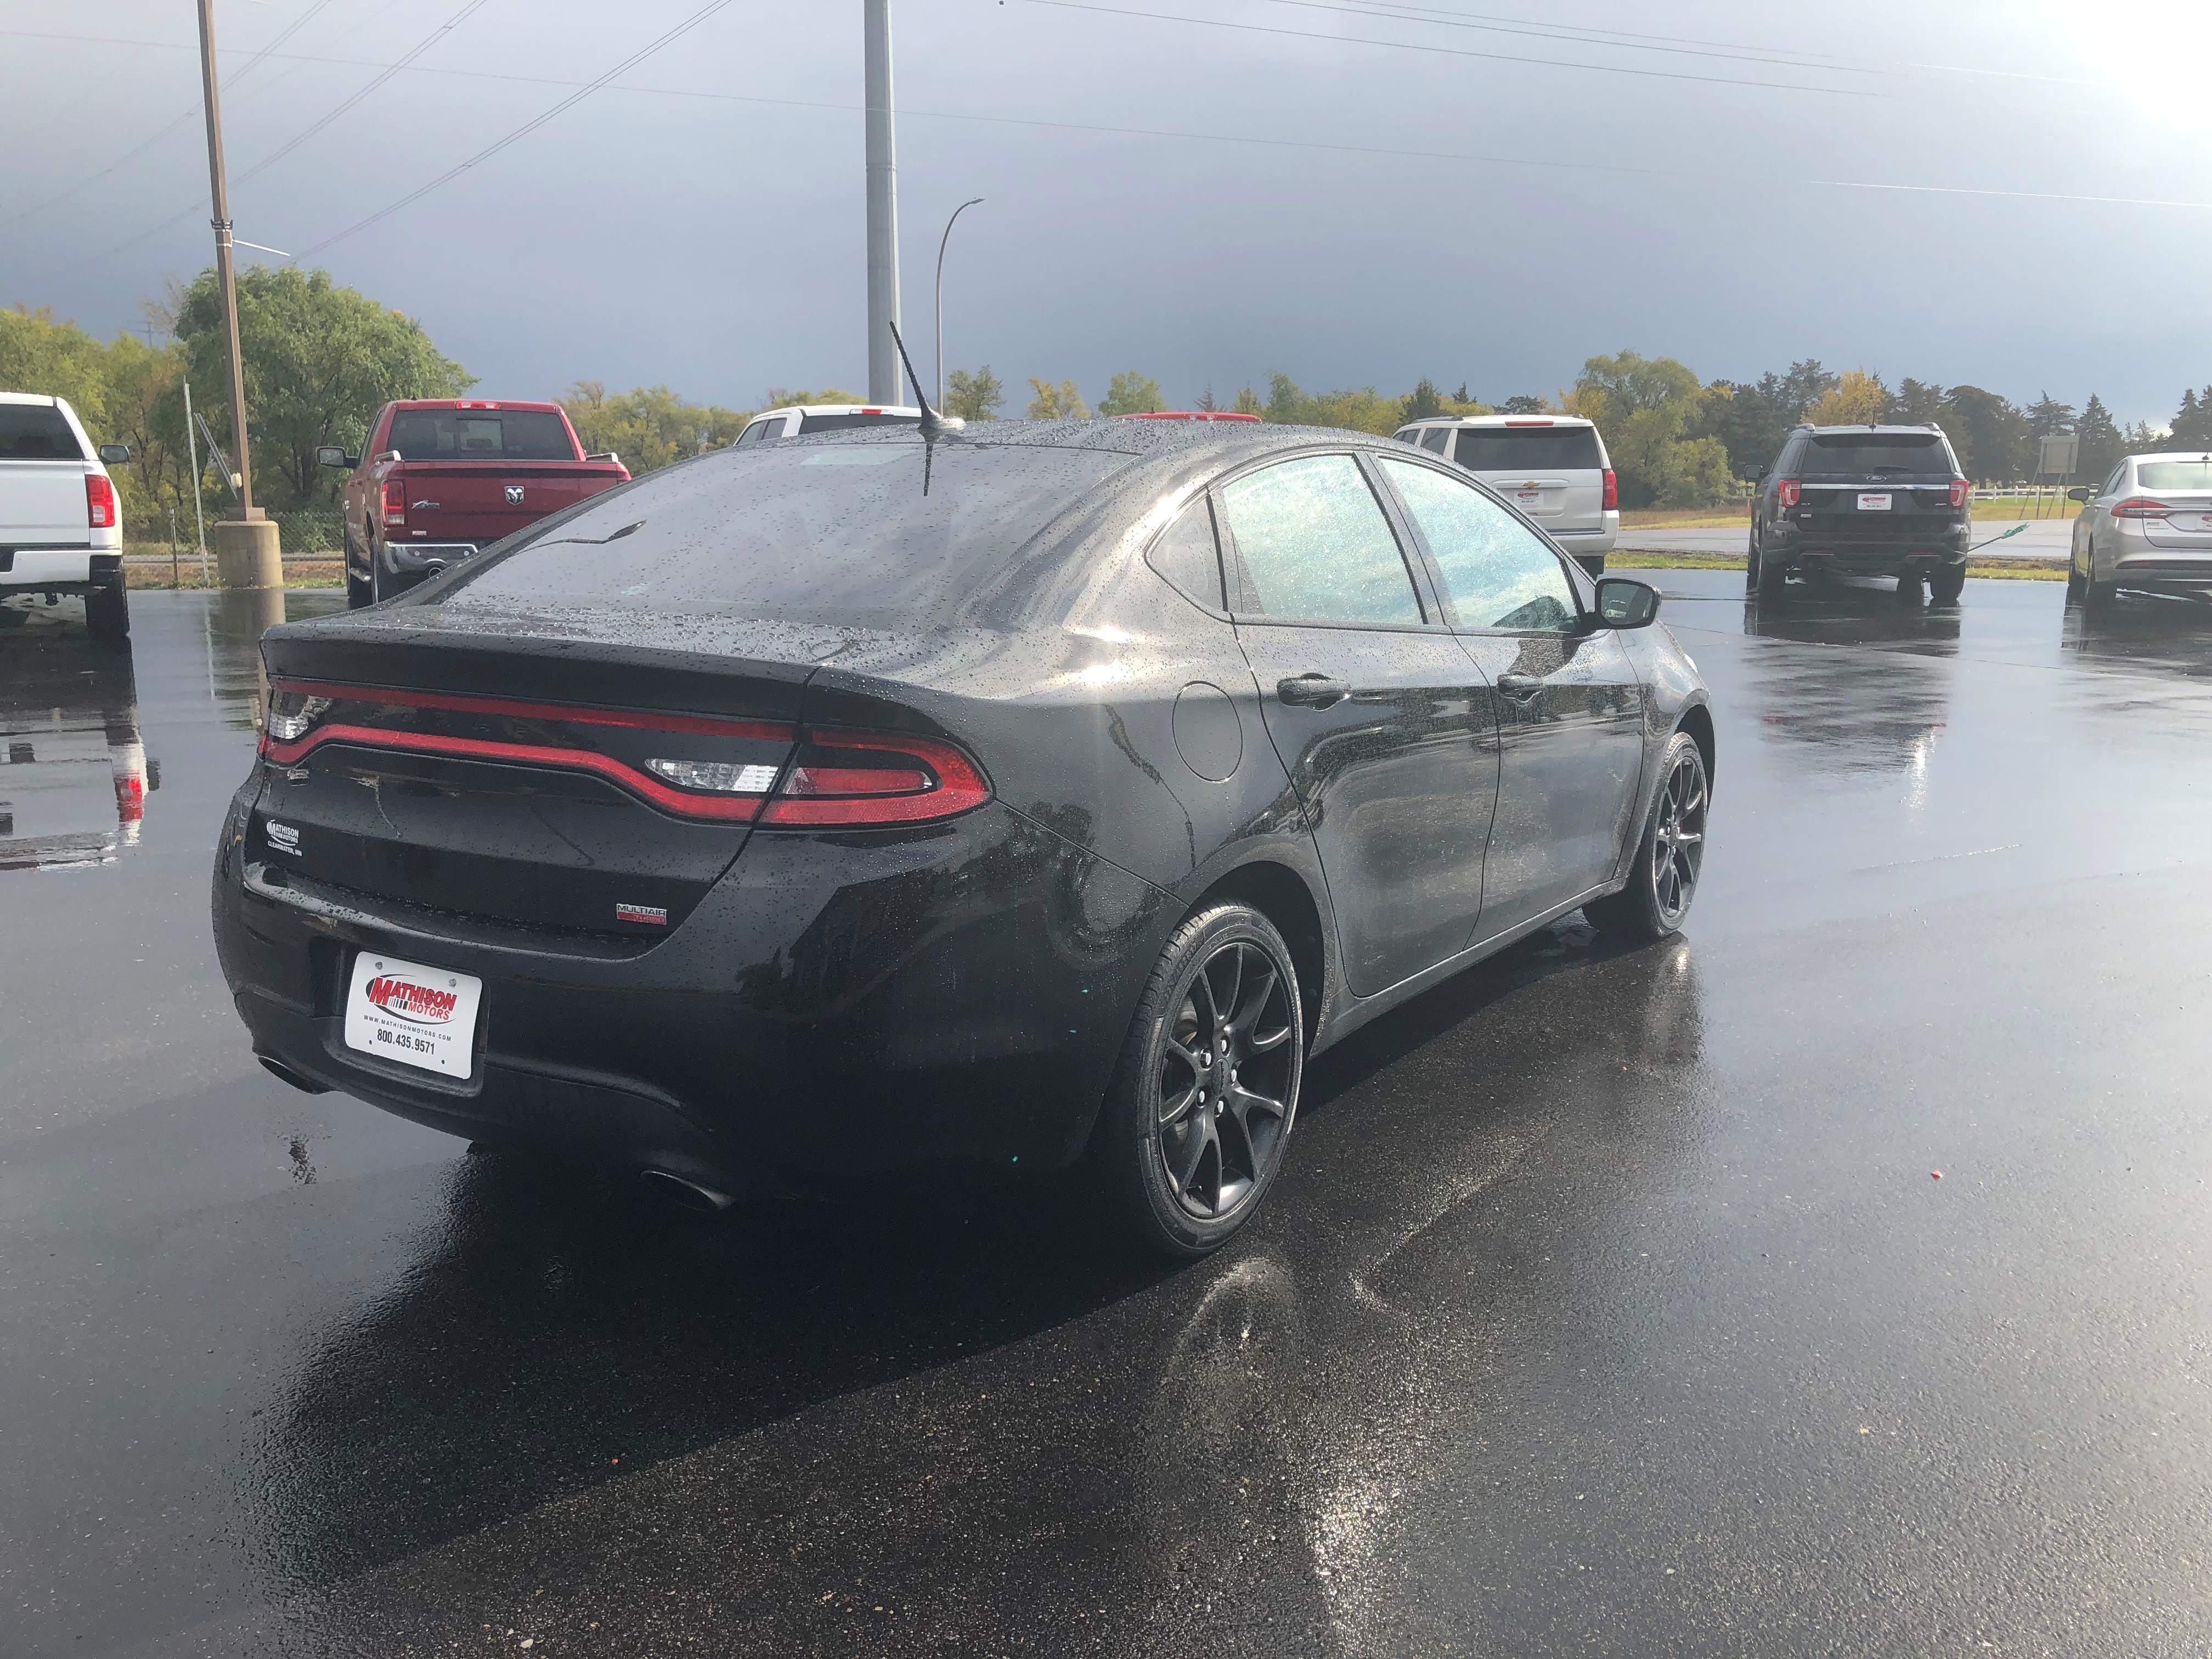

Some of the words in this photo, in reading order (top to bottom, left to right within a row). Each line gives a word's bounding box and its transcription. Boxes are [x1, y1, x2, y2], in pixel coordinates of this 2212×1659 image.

[268, 822, 299, 838] MATHISON
[282, 834, 298, 843] MOTORS
[617, 905, 665, 916] MULTIAIR
[634, 915, 664, 923] TURBO
[369, 977, 458, 1011] MATHISON
[408, 1002, 450, 1020] MOTORS
[364, 1015, 452, 1041] WWW.MATHISONMOTORS.COM
[377, 1029, 435, 1054] 800.435.9571
